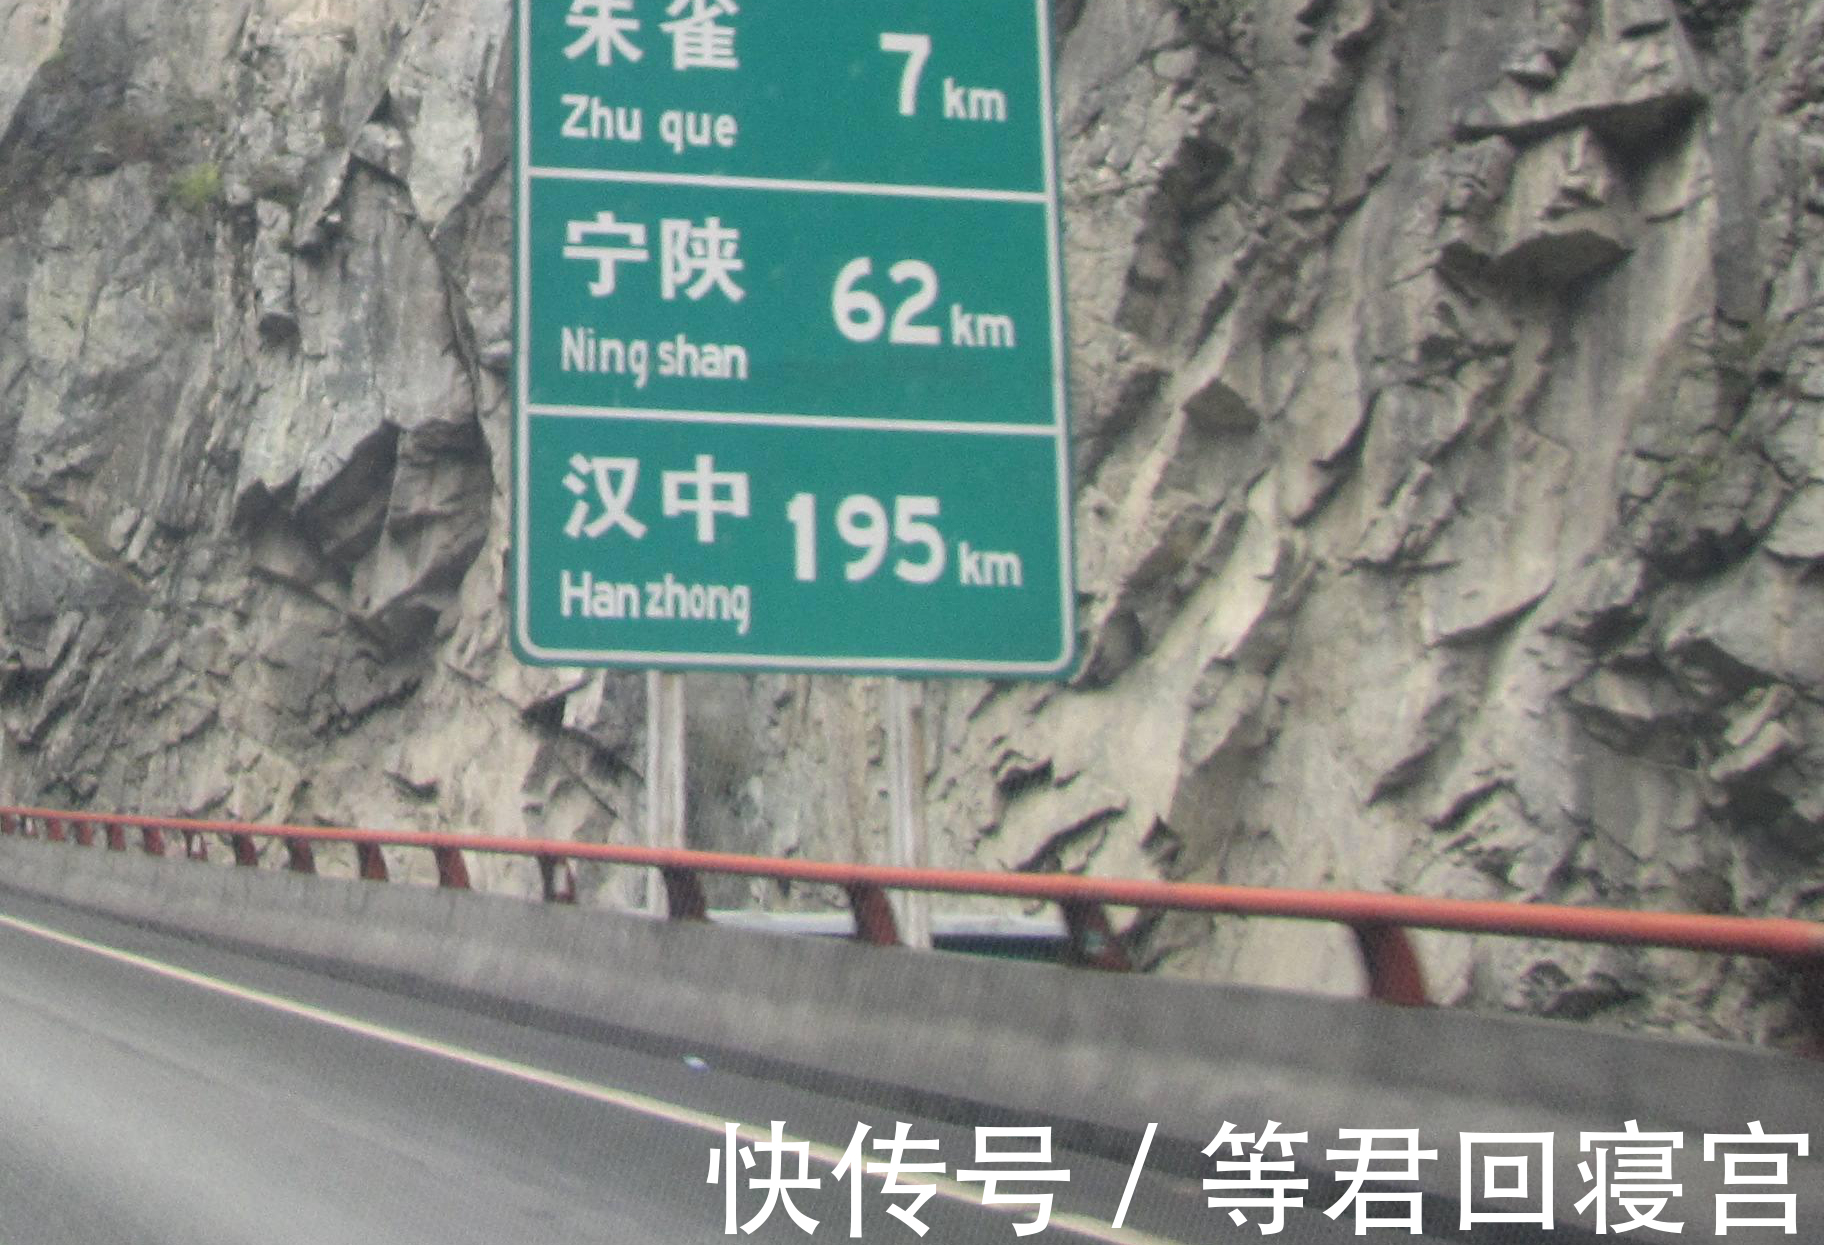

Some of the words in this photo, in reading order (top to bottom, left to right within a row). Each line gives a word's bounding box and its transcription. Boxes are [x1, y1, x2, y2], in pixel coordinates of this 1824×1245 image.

[879, 32, 932, 116] 7
[943, 77, 1007, 121] km
[560, 93, 643, 142] Zhu
[659, 109, 738, 154] que
[562, 210, 746, 303] 宁陕
[831, 255, 943, 346] 62
[950, 304, 1015, 348] km
[562, 452, 751, 544] 汉中
[785, 491, 948, 584] 195
[958, 541, 1023, 587] km
